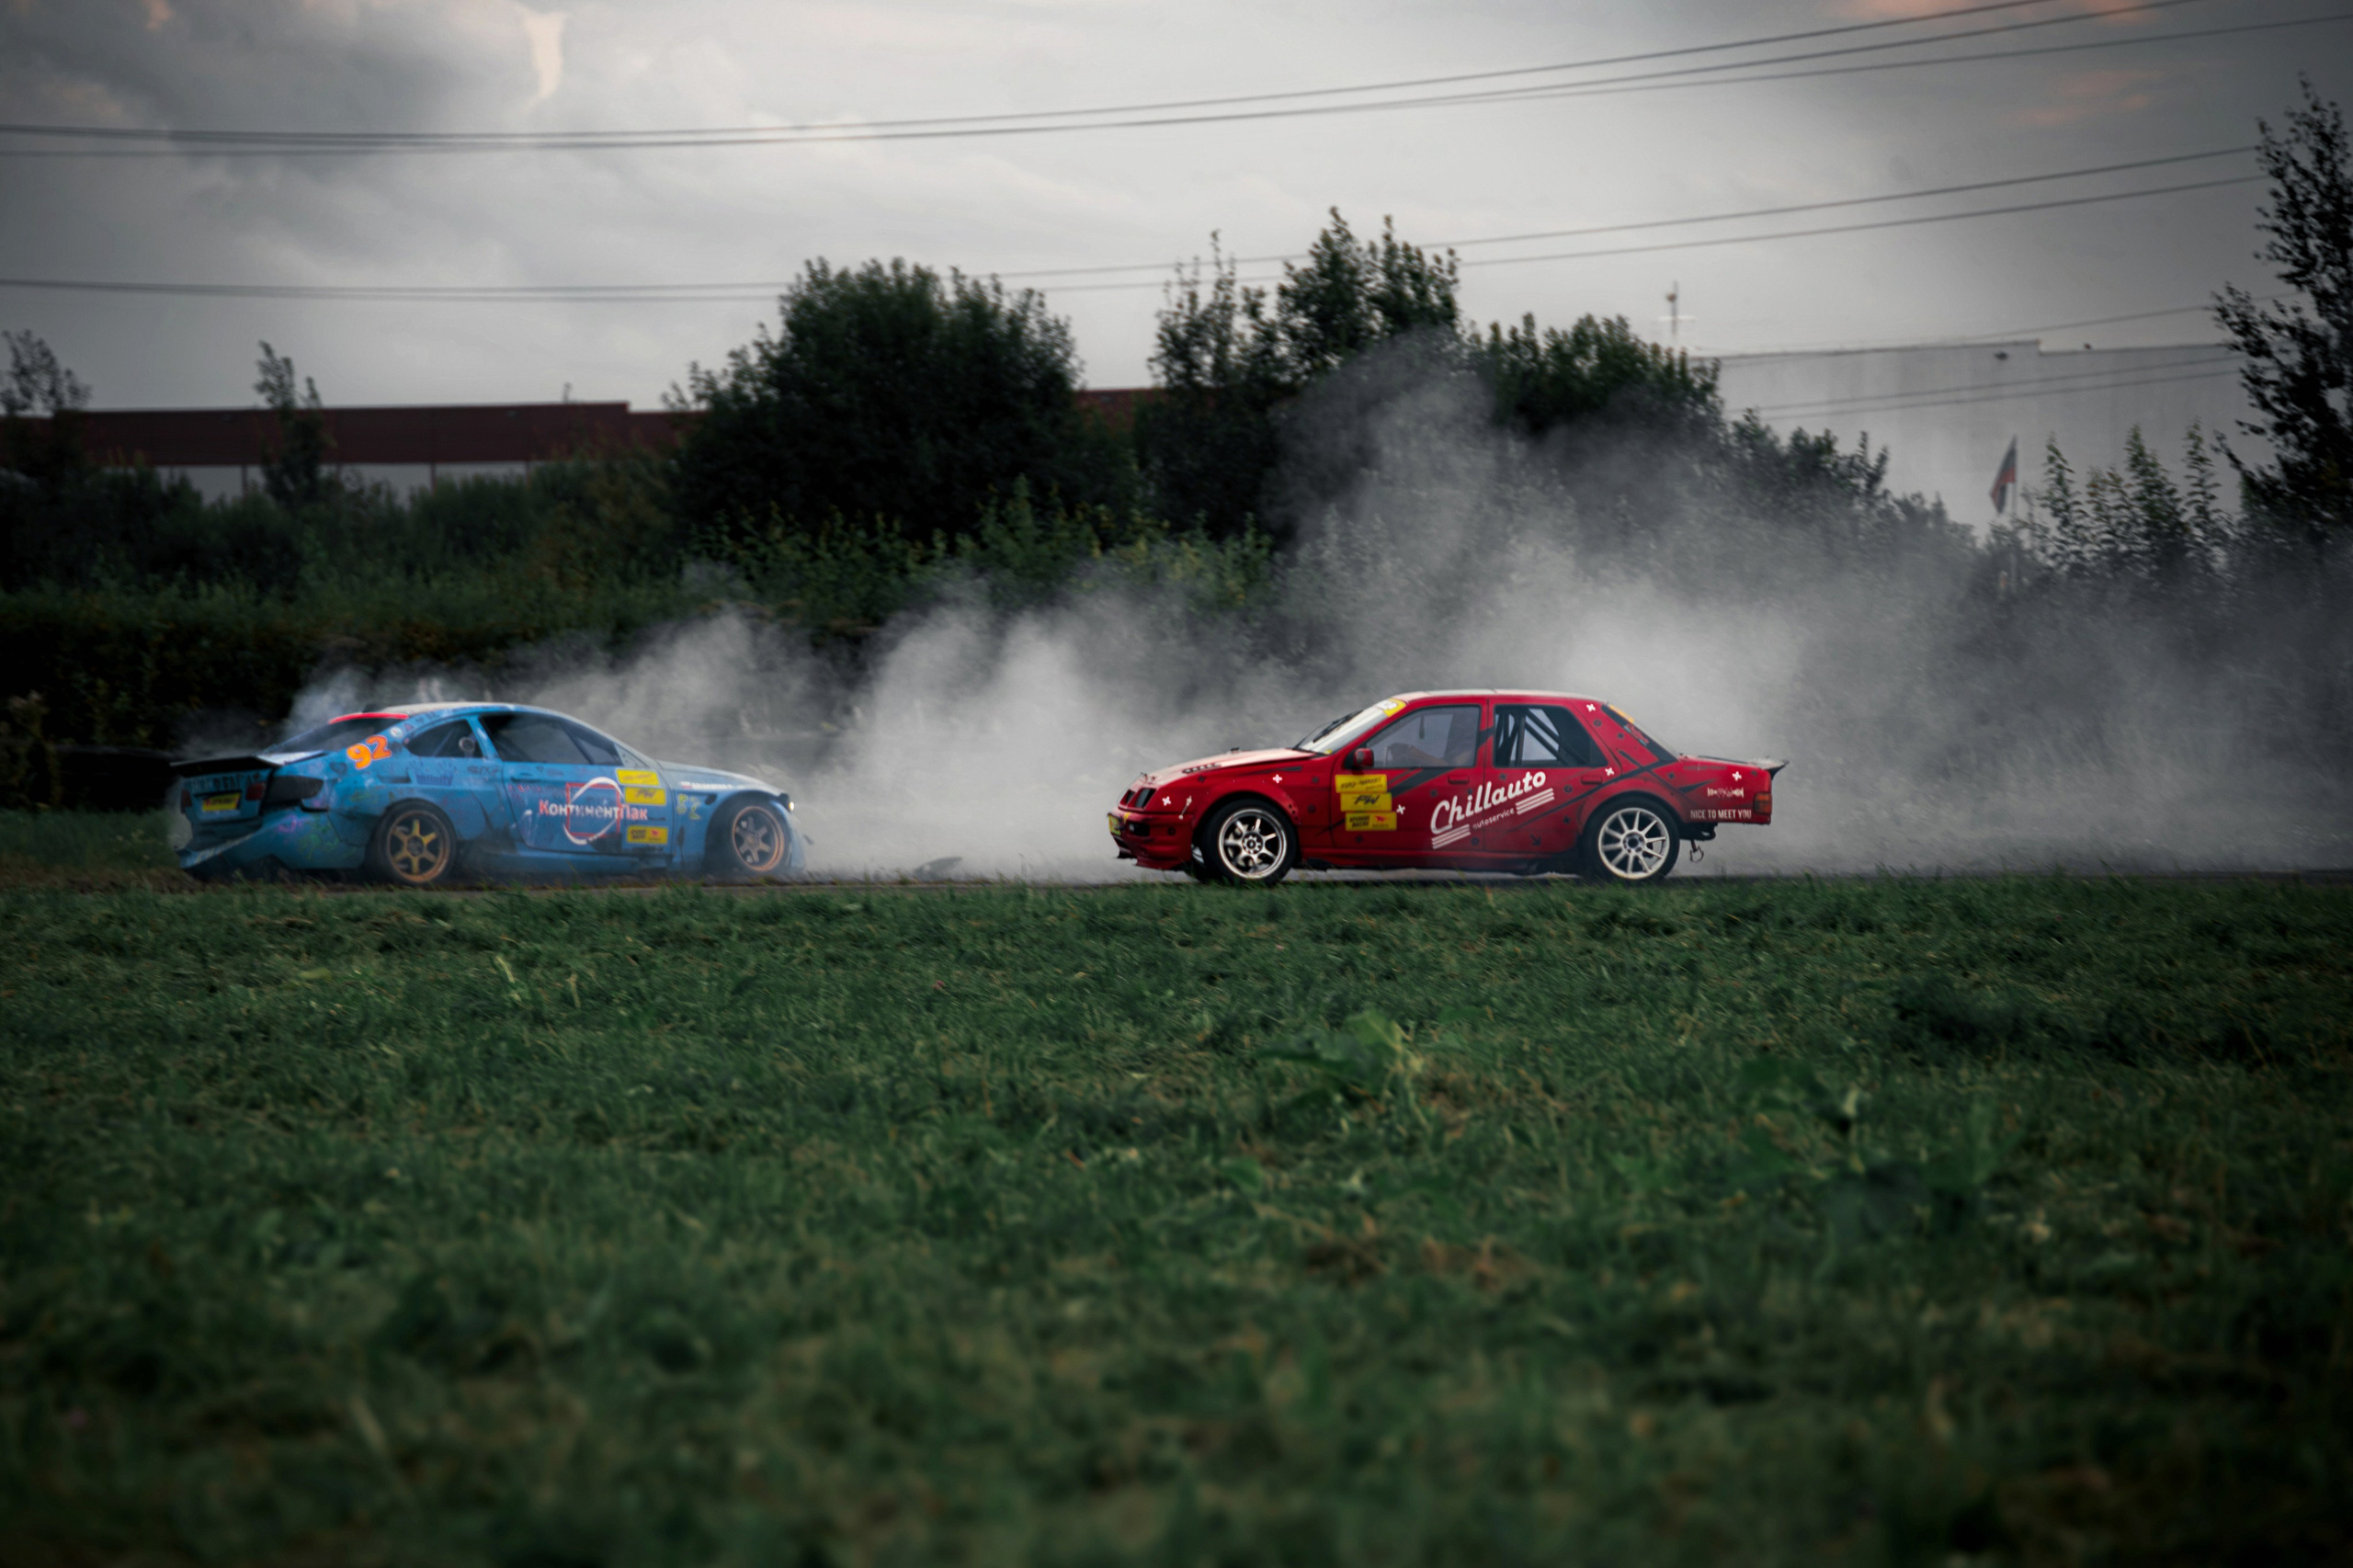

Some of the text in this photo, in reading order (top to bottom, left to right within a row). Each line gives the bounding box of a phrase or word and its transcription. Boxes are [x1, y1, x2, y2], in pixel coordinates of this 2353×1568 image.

[347, 733, 392, 770] 92
[538, 798, 648, 821] КонтинентПак
[1430, 771, 1546, 835] Chillauto
[1689, 809, 1752, 820] NICE TO MEET YOU
[1472, 807, 1515, 830] autoservice
